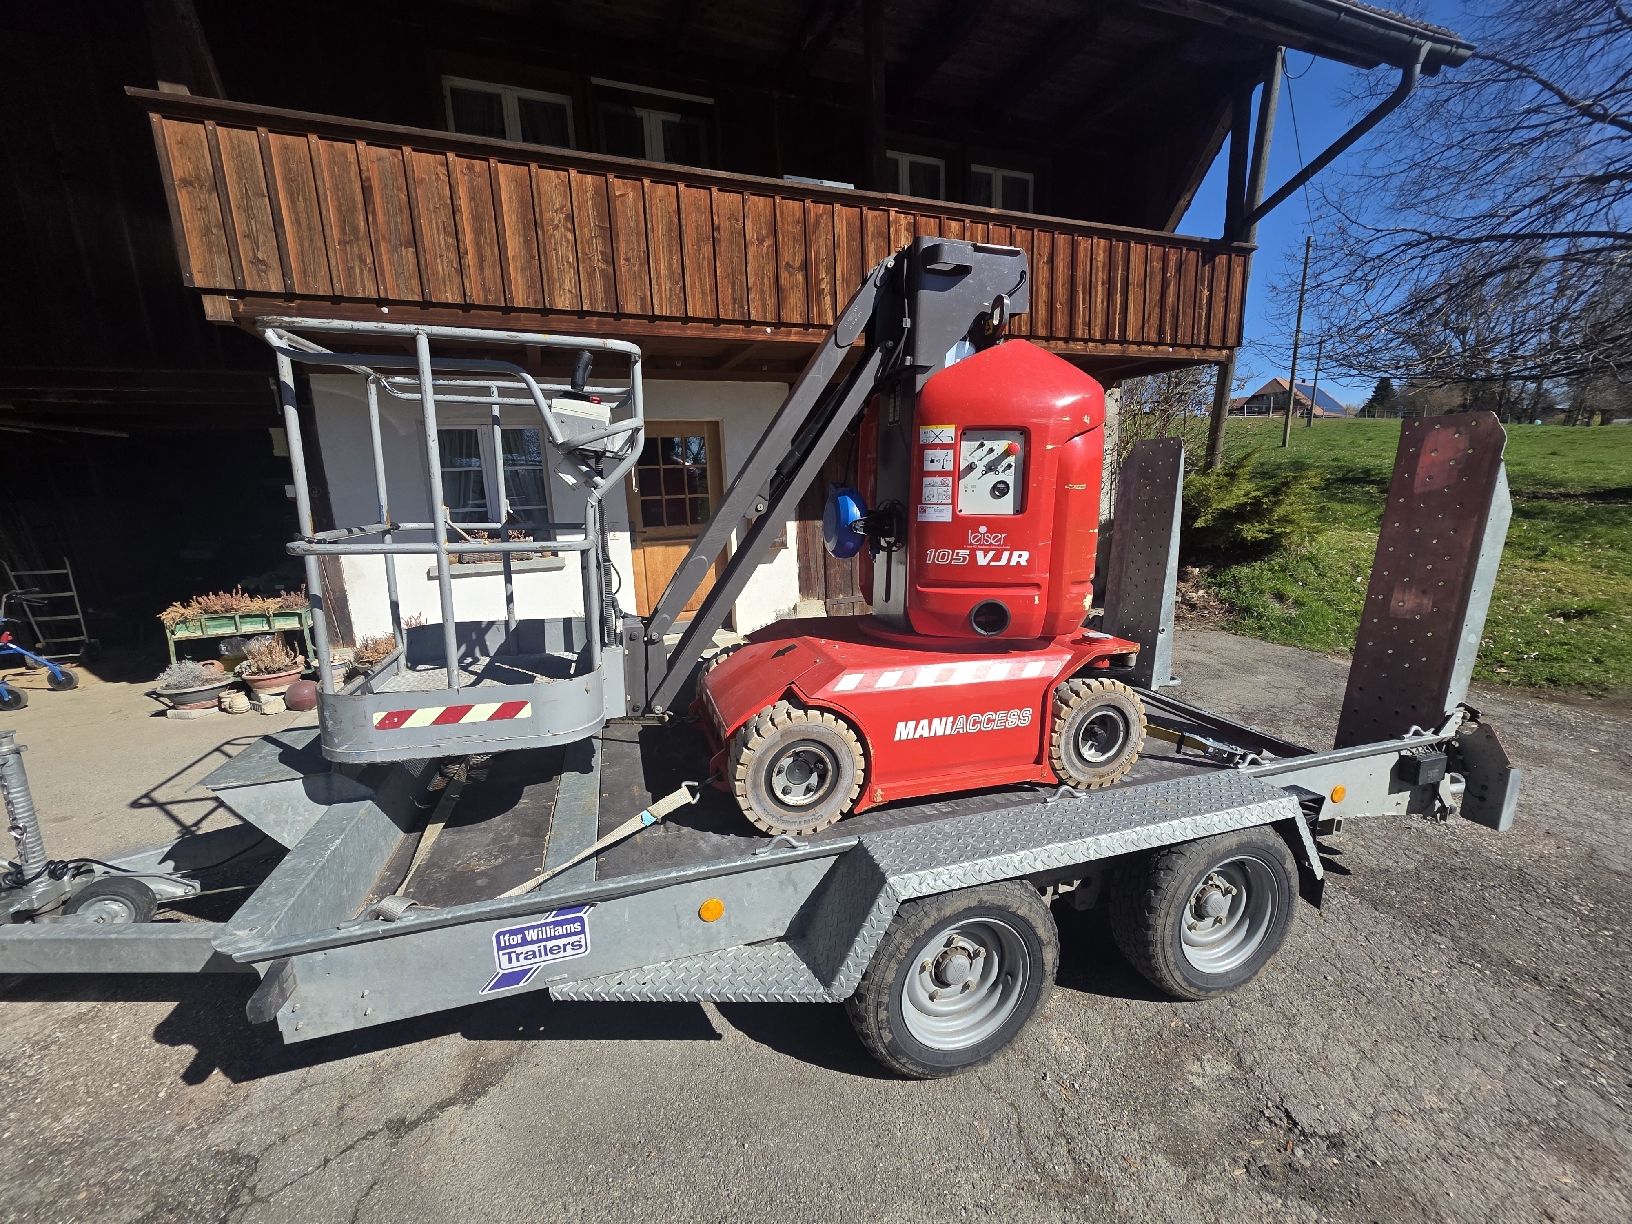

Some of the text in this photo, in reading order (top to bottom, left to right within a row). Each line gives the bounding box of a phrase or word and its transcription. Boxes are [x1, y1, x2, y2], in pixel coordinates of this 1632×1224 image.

[968, 525, 1008, 545] leiser
[926, 549, 1030, 566] 105 VJR
[499, 921, 582, 947] Ifor Williams
[501, 938, 584, 965] Trailers
